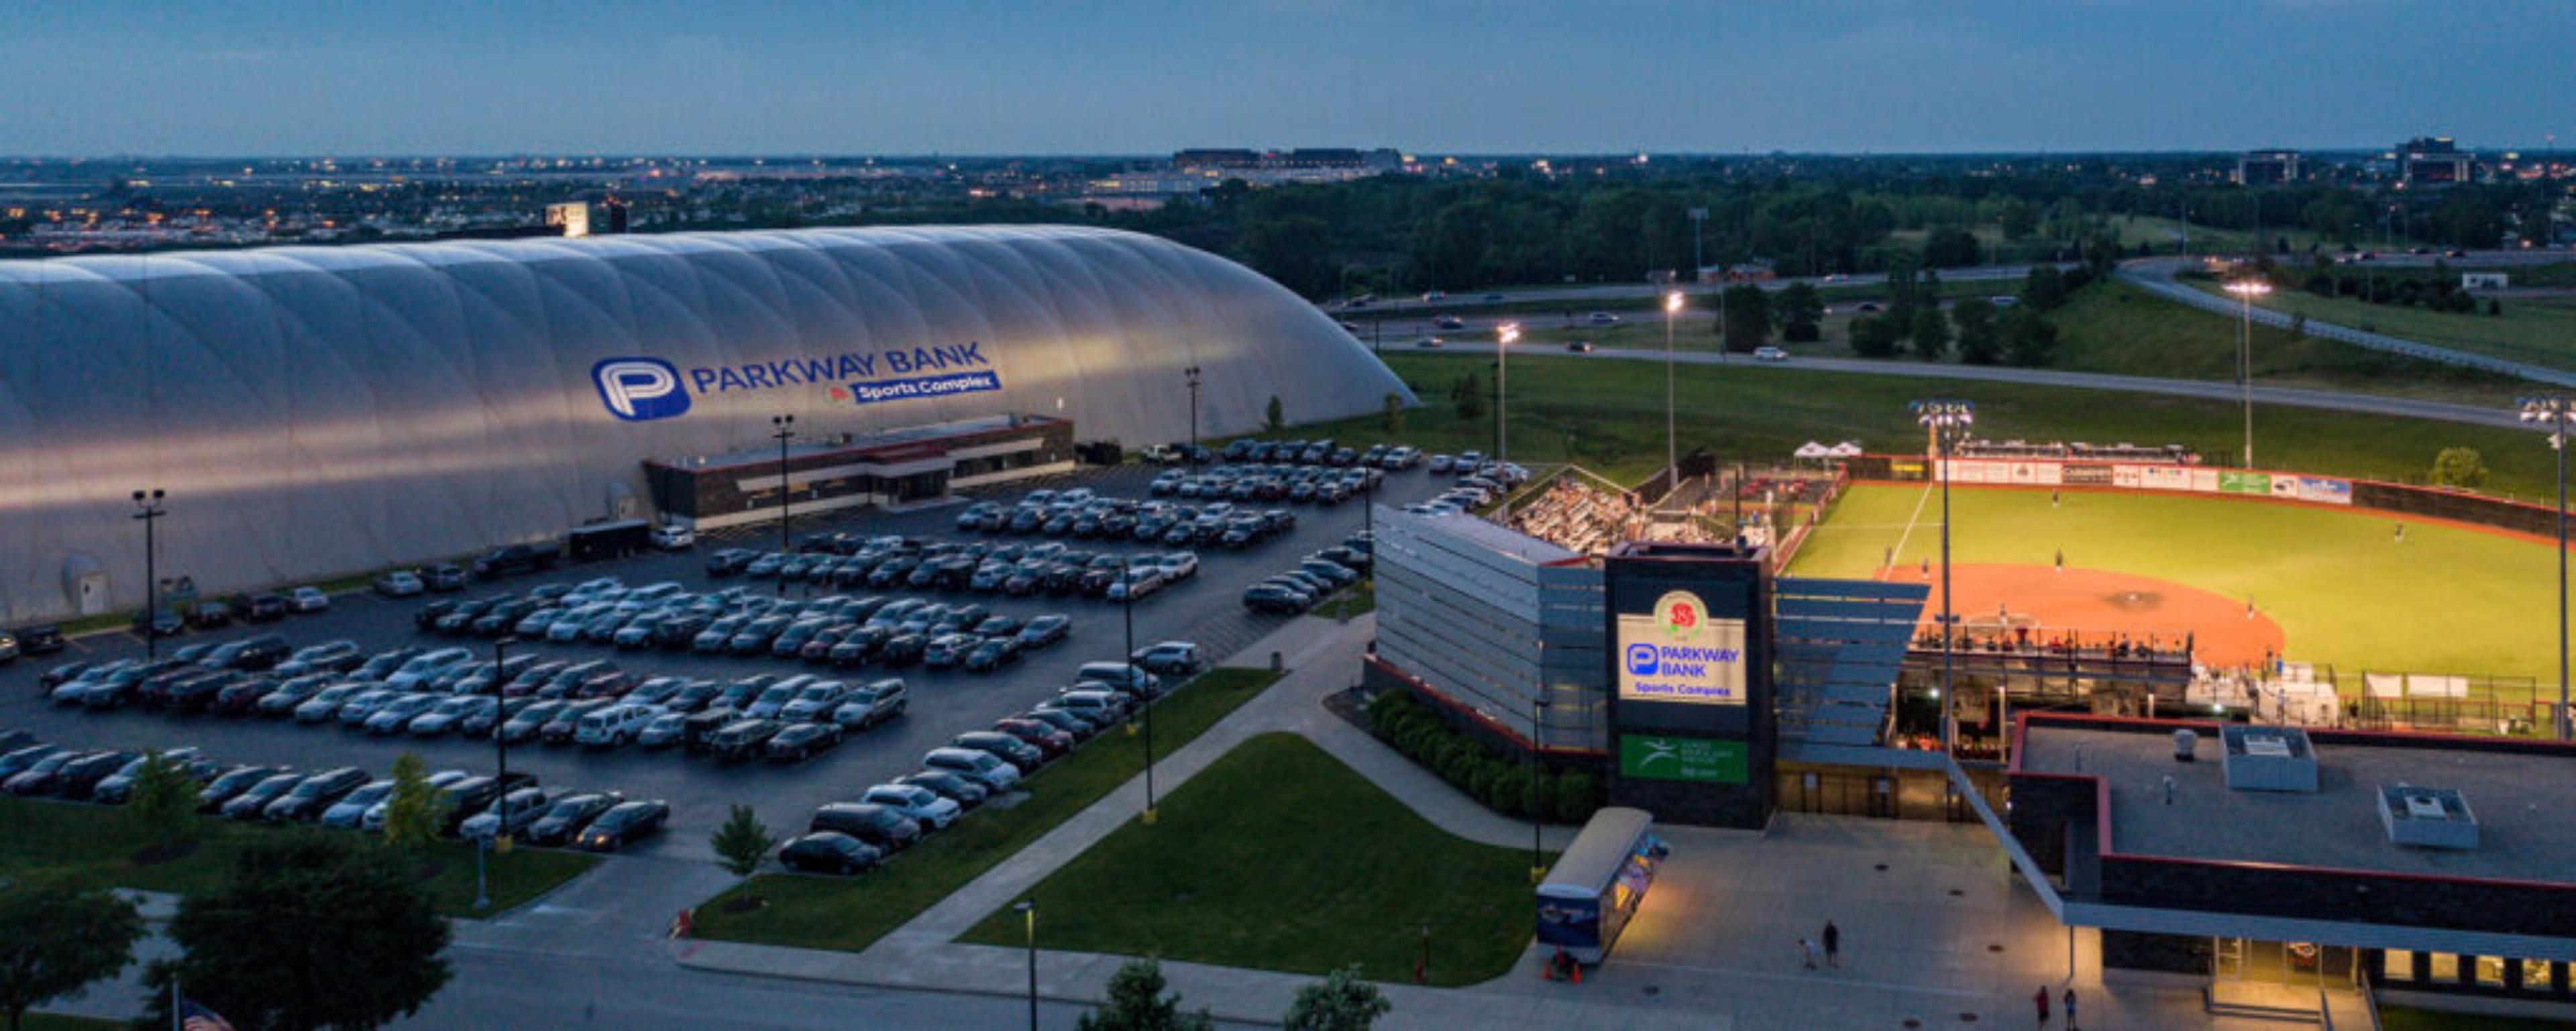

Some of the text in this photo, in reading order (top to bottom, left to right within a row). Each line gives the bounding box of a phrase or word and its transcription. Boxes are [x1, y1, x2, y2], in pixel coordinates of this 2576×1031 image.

[691, 341, 988, 394] PARKWAY BANK
[858, 376, 992, 400] Sports Complex
[1660, 645, 1739, 663] PARKWAY
[1660, 661, 1707, 677] BANK
[1635, 681, 1731, 697] Sports Complex
